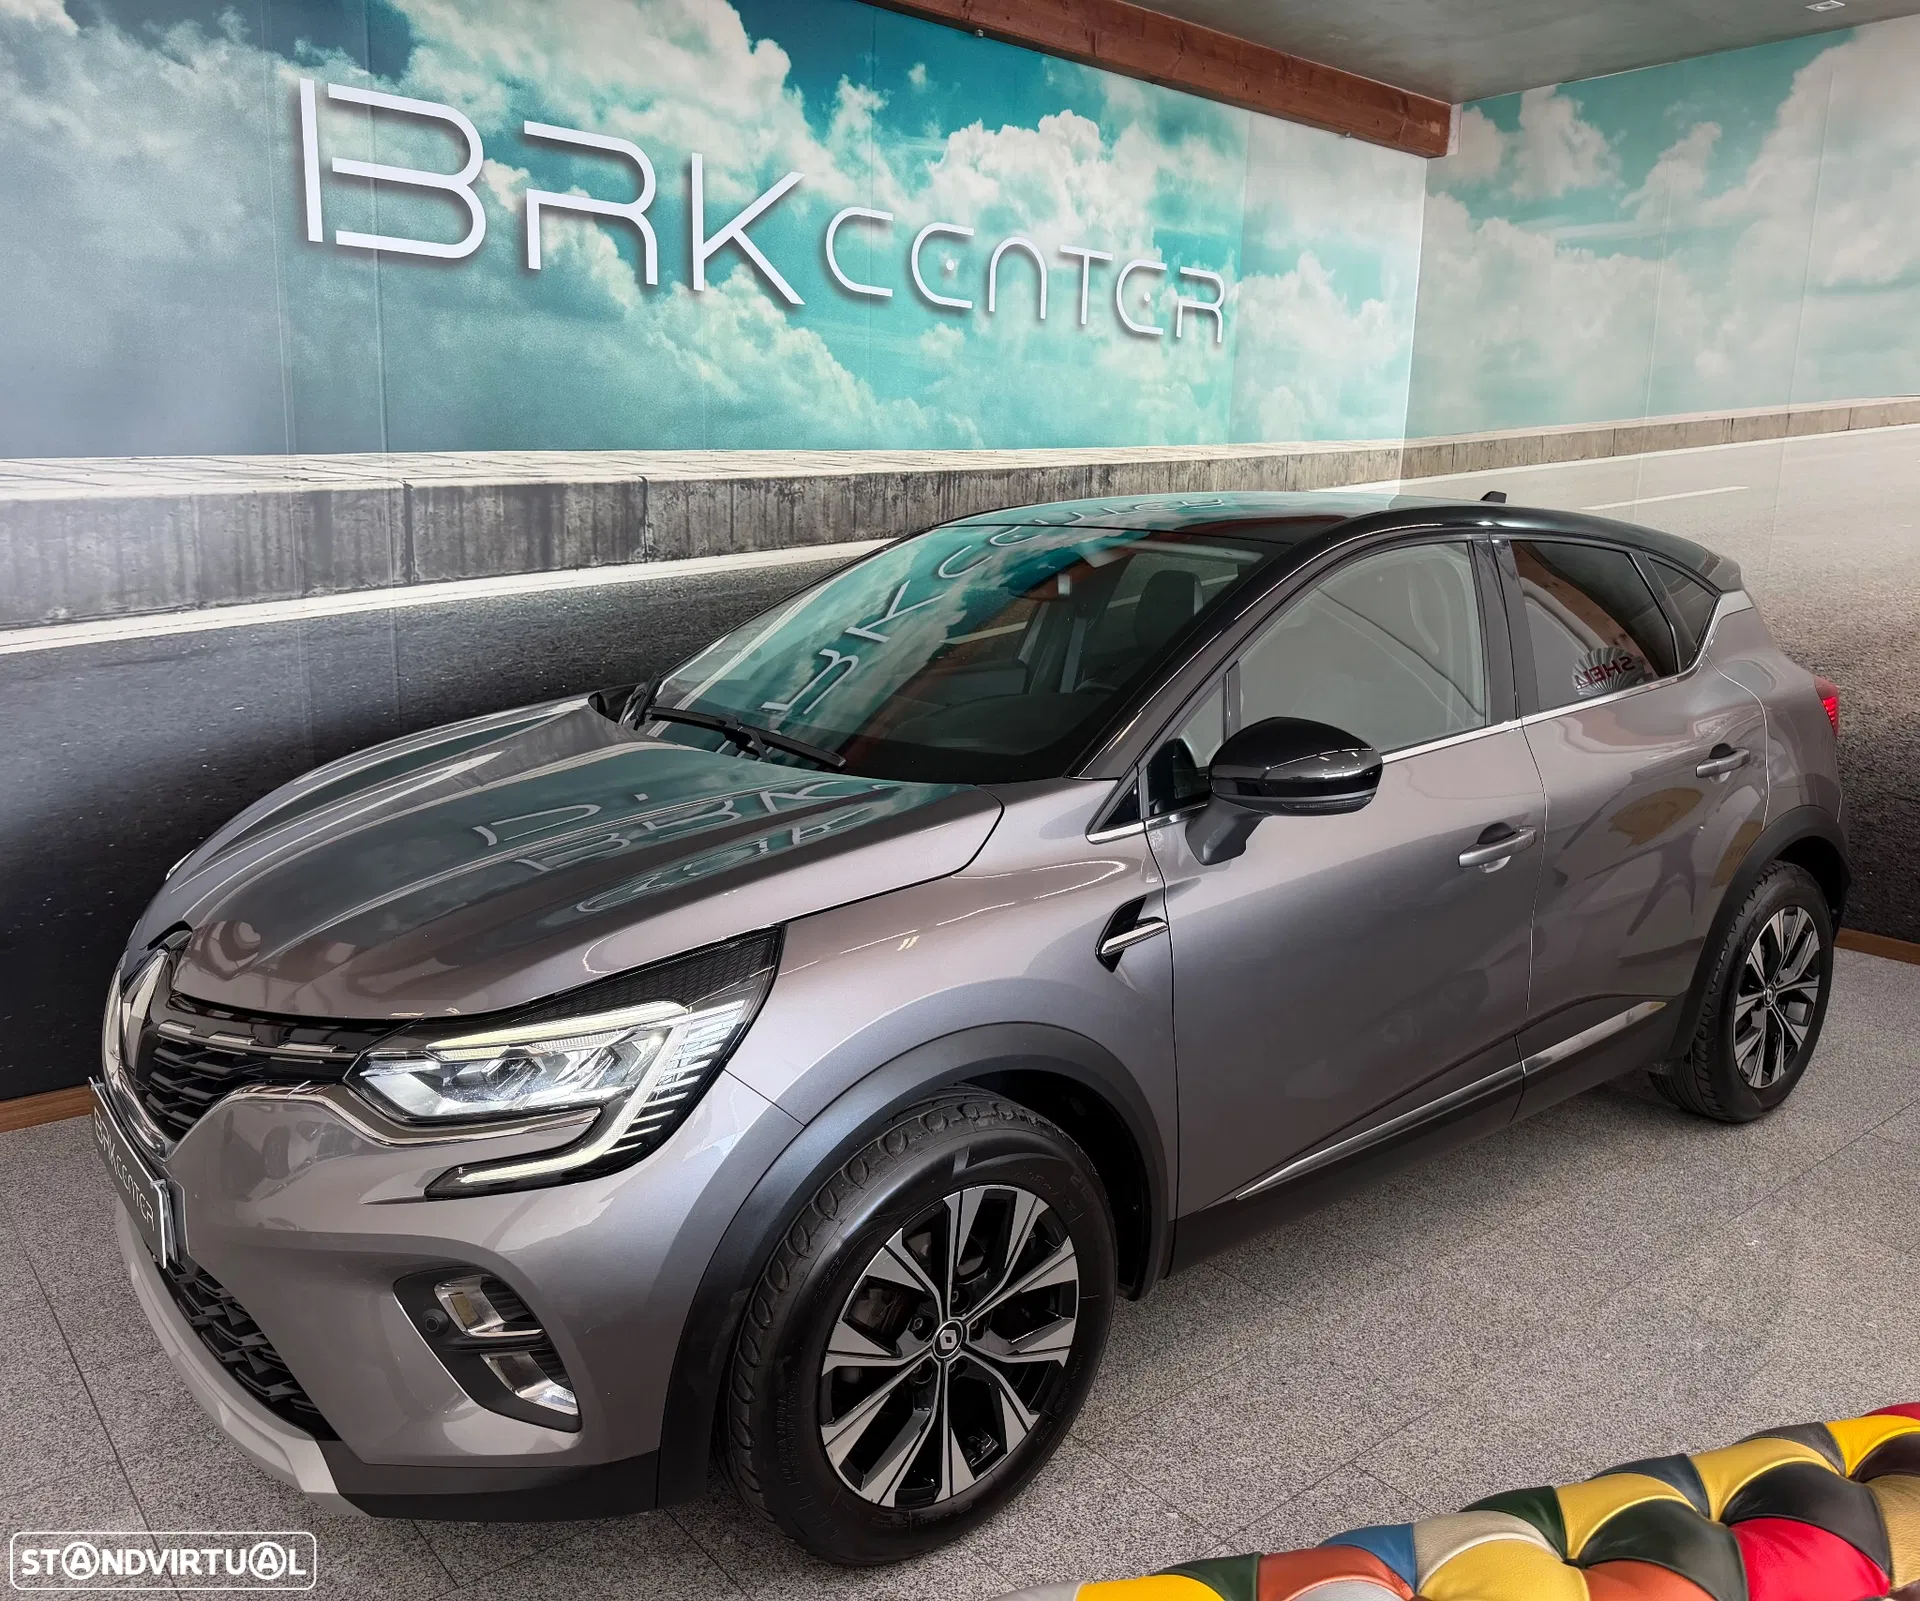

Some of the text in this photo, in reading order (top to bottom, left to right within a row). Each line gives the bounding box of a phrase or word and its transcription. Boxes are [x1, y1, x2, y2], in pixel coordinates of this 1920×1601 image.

[300, 78, 1226, 343] BRK CENTER
[94, 1106, 155, 1232] BRK CENTER
